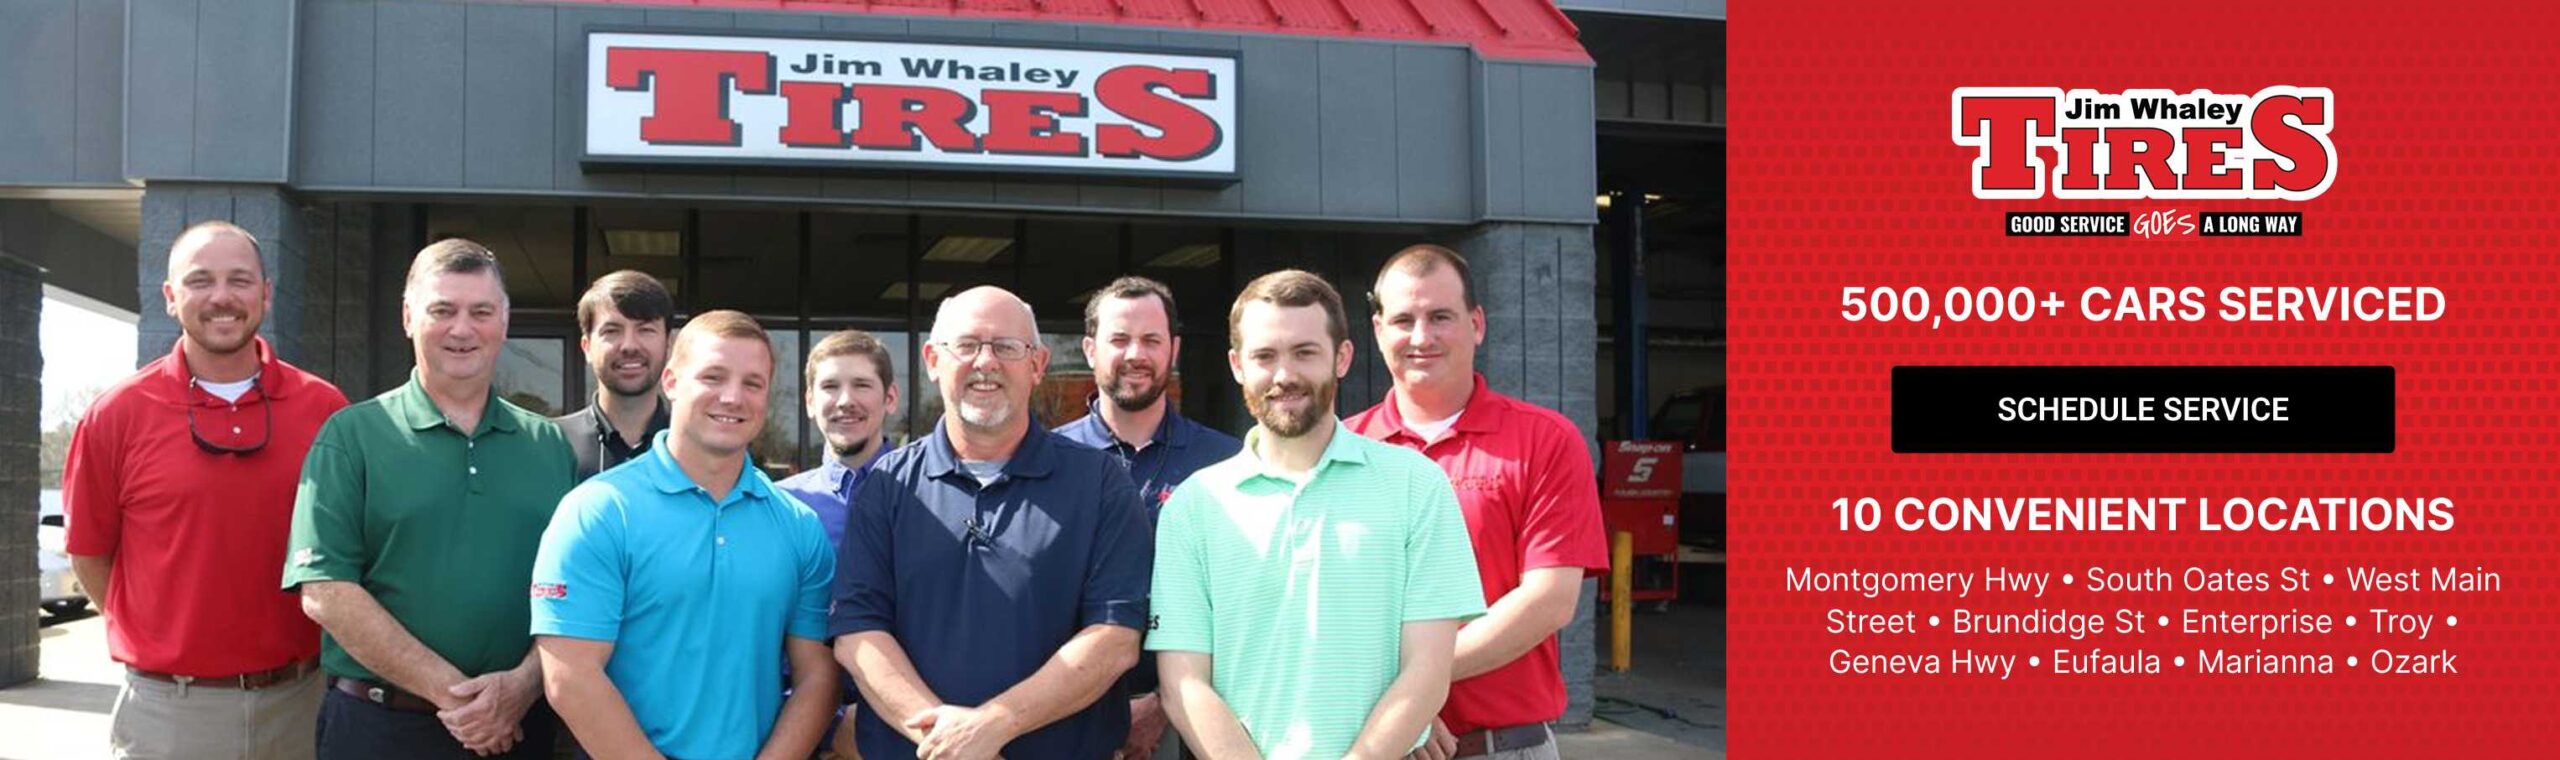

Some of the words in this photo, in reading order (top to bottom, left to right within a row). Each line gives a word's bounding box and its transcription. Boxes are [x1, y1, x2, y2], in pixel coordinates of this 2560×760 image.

[605, 45, 1224, 162] TIRES
[790, 54, 882, 77] Jim
[900, 57, 1080, 89] Whaley
